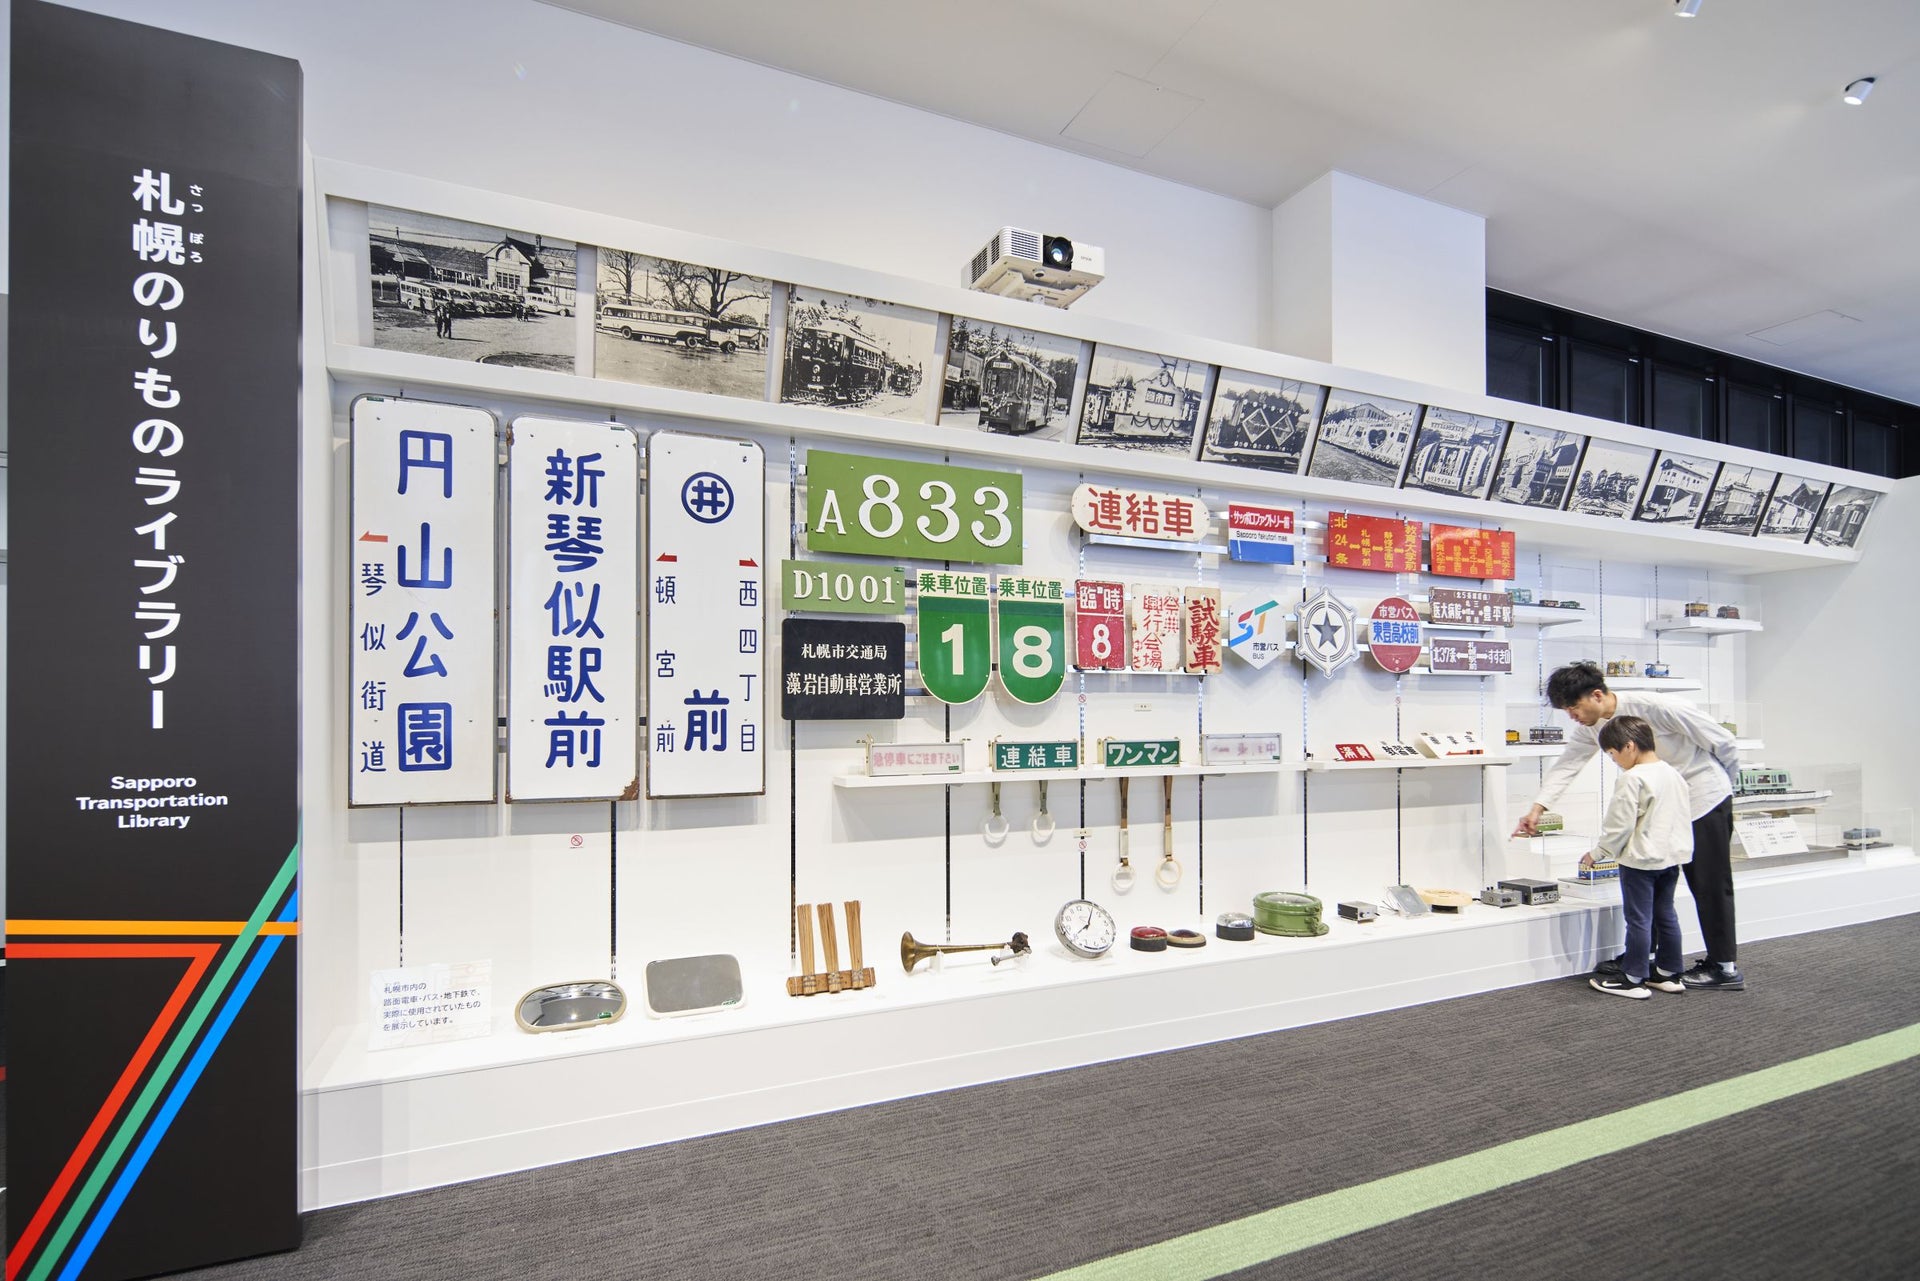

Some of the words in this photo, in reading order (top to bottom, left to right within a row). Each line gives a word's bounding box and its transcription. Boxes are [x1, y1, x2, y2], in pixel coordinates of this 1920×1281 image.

[189, 183, 204, 264] さっぽろ
[131, 169, 185, 730] 札幌のりものライブラリー
[1088, 487, 1195, 537] 連結車
[792, 570, 896, 604] D1001
[918, 572, 989, 597] 乗車位置
[998, 577, 1063, 600] 乗車位置
[396, 429, 454, 772] 円山公園
[544, 448, 606, 769] 新琴似駅前
[1080, 586, 1121, 611] 臨時
[1432, 602, 1463, 620] 医大病院
[1378, 605, 1415, 620] 市営バス
[1091, 623, 1112, 659] 8
[1142, 594, 1163, 669] 興行会場
[1187, 597, 1220, 669] 試験車
[1372, 620, 1419, 644] 東豊高校前
[800, 644, 888, 661] 札幌市交通局
[941, 623, 965, 676] 1
[1011, 625, 1053, 679] 8
[1252, 642, 1279, 651] 市営バス
[1252, 652, 1265, 660] BUS
[359, 562, 387, 774] 琴似街道
[655, 575, 677, 753] 頓宮前
[739, 580, 758, 753] 西四丁目
[785, 671, 903, 697] 藻岩自動車営業所
[684, 688, 730, 752] 前
[1001, 745, 1073, 768] 連結車
[1108, 743, 1178, 765] ワンマン
[110, 773, 198, 792] Sapporo
[75, 790, 229, 812] Transportation
[117, 812, 190, 831] Library
[384, 982, 427, 994] 札幌市内の
[383, 1000, 481, 1019] 実際に使用されていたもの
